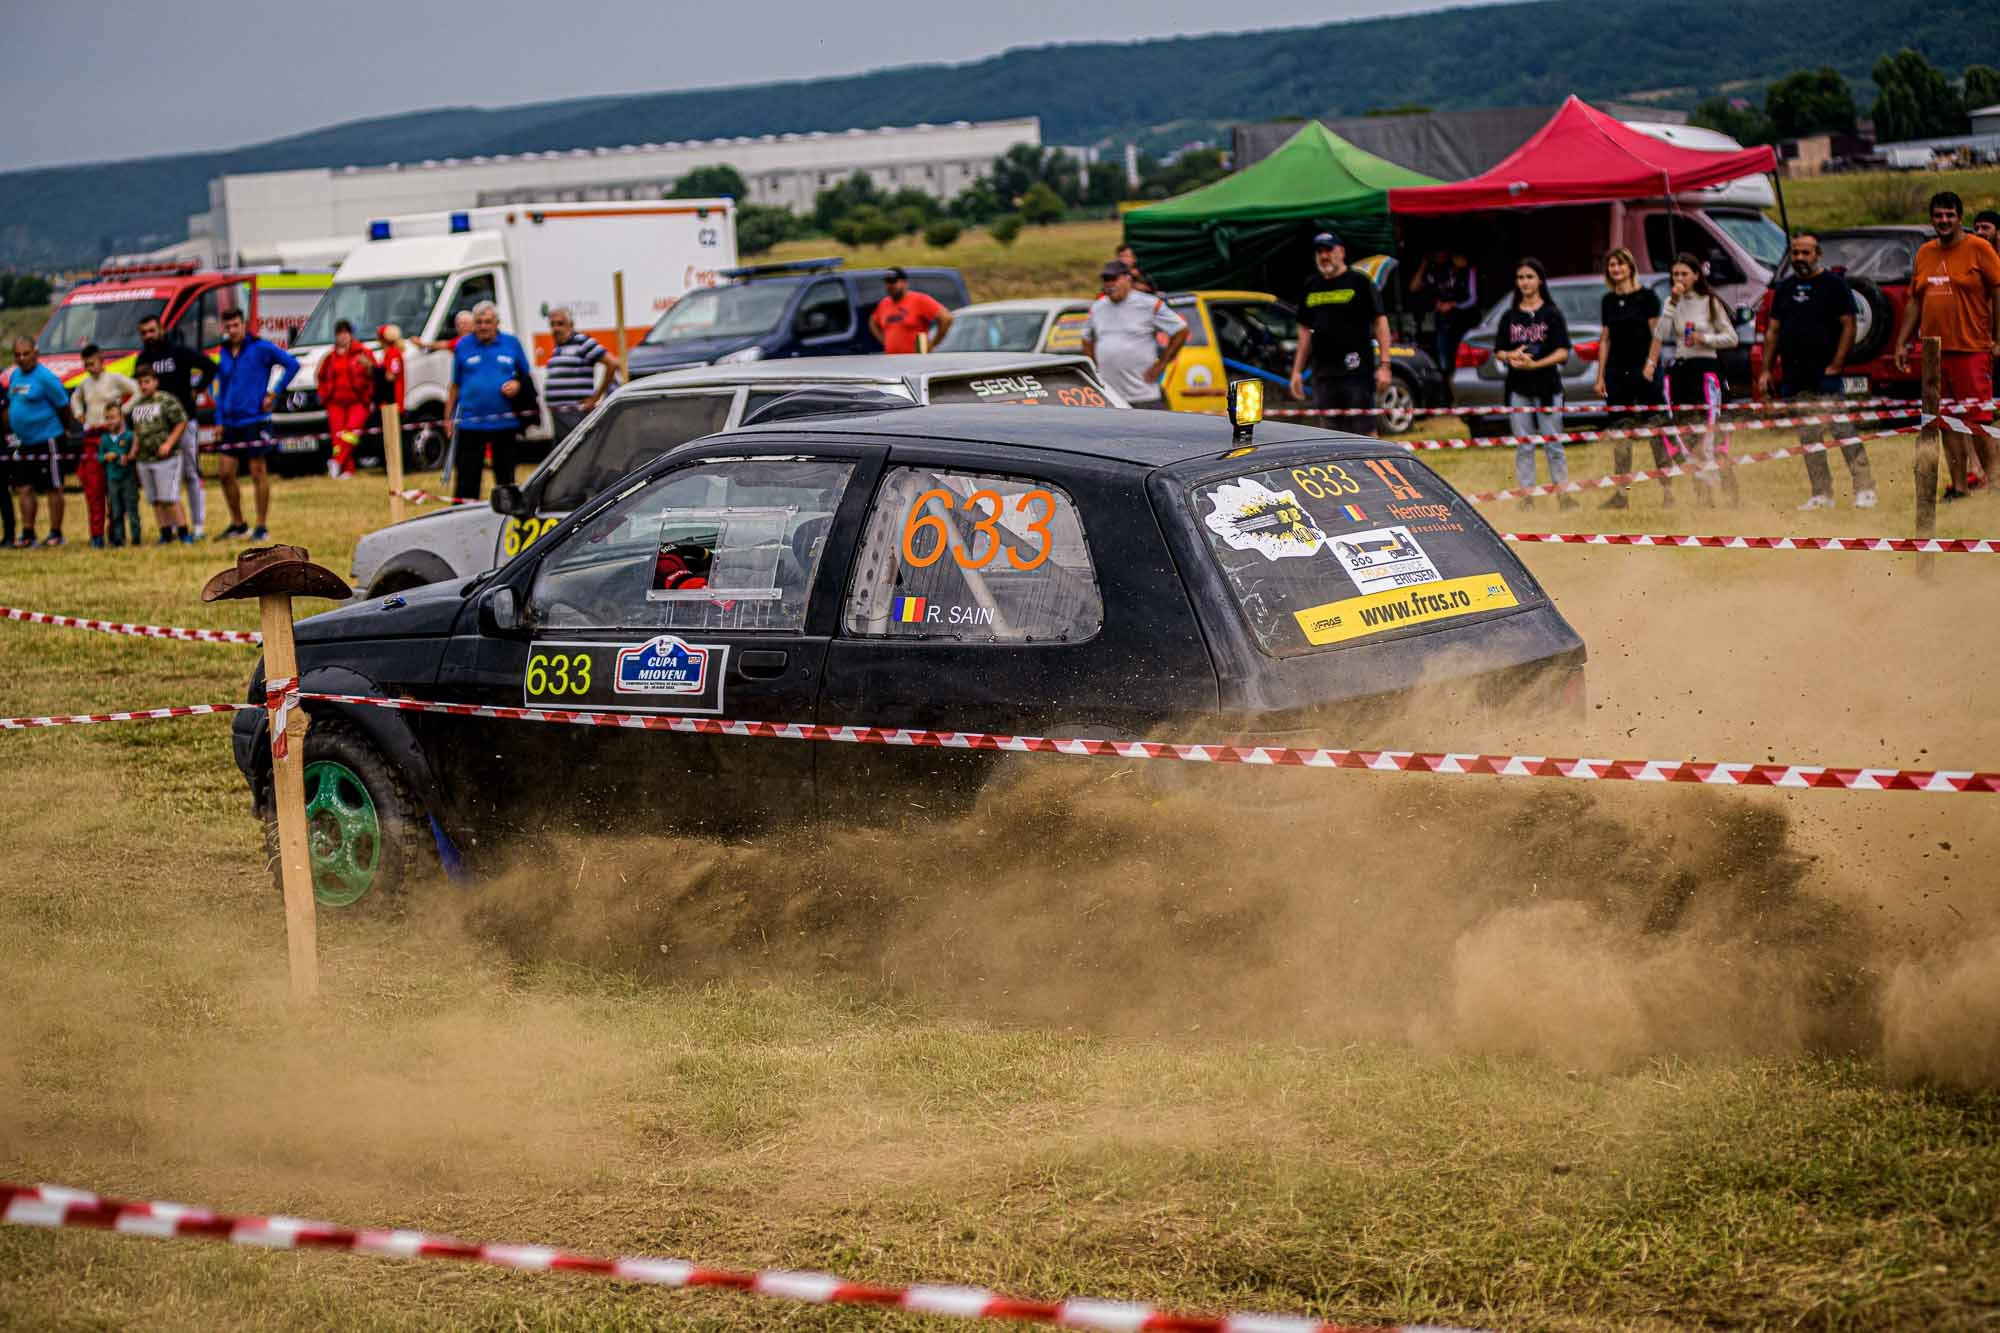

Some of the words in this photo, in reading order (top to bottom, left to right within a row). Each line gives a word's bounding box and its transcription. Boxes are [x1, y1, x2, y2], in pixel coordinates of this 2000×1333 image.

[699, 229, 716, 245] C2
[970, 375, 1043, 397] SERUS
[1291, 464, 1360, 499] 633
[902, 488, 1057, 571] 633
[1393, 569, 1438, 586] ERICSEM
[926, 605, 944, 623] R.
[948, 605, 995, 625] SAIN
[1359, 588, 1471, 627] www.fras.ro
[1316, 615, 1343, 629] FRAS
[647, 656, 678, 668] CUPA
[526, 653, 592, 695] 633
[638, 669, 687, 681] MIOVENI
